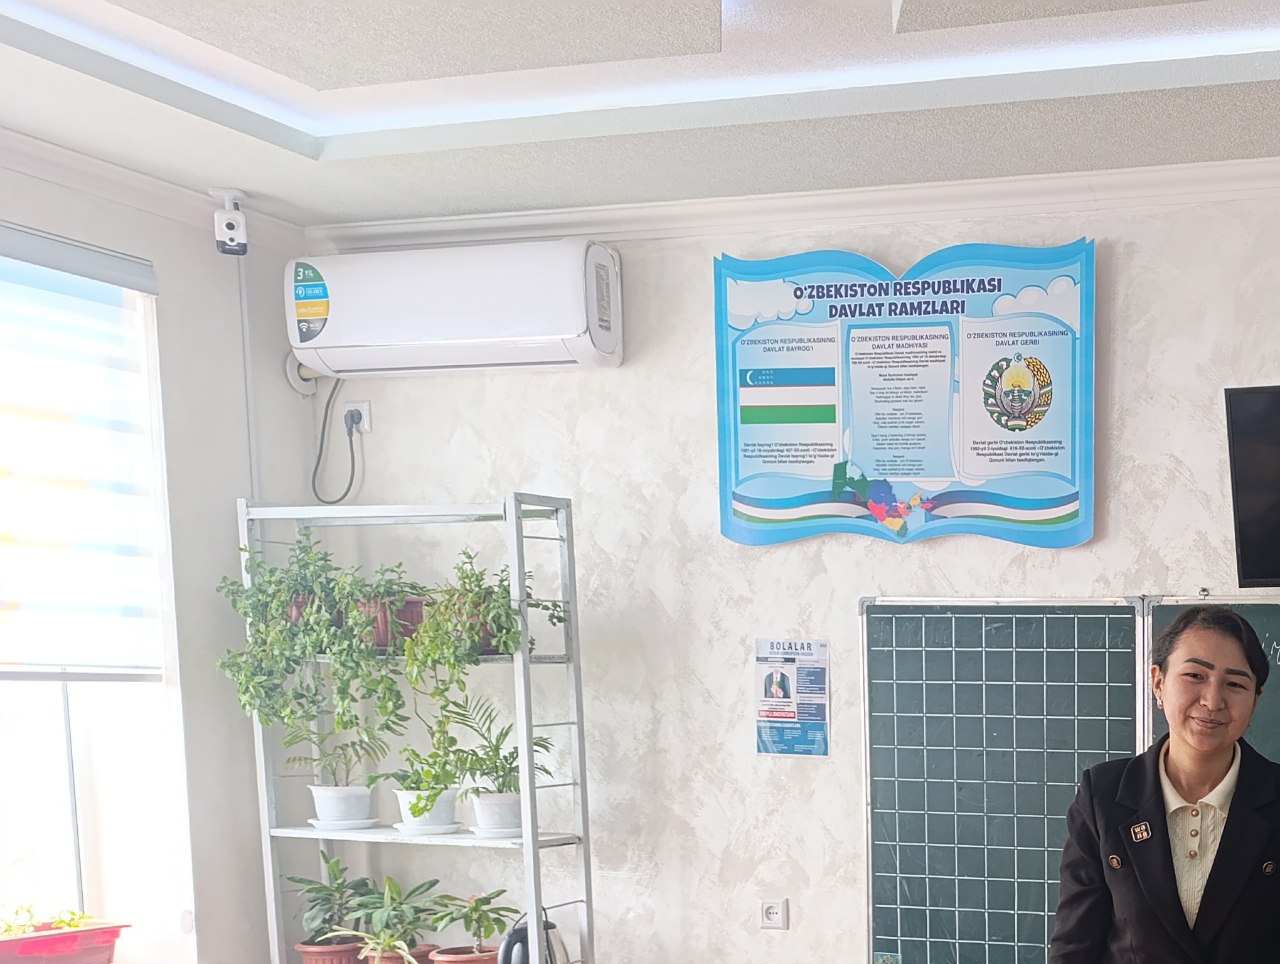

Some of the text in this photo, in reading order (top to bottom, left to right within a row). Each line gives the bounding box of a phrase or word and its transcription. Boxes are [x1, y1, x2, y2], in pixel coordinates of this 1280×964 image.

[297, 268, 303, 280] 3
[893, 278, 1002, 296] RESPUBLIKASI
[829, 300, 966, 318] DAVLAT RAMZLARI
[1009, 330, 1068, 338] RESPUBLIKASINING
[770, 642, 812, 651] BOLALAR
